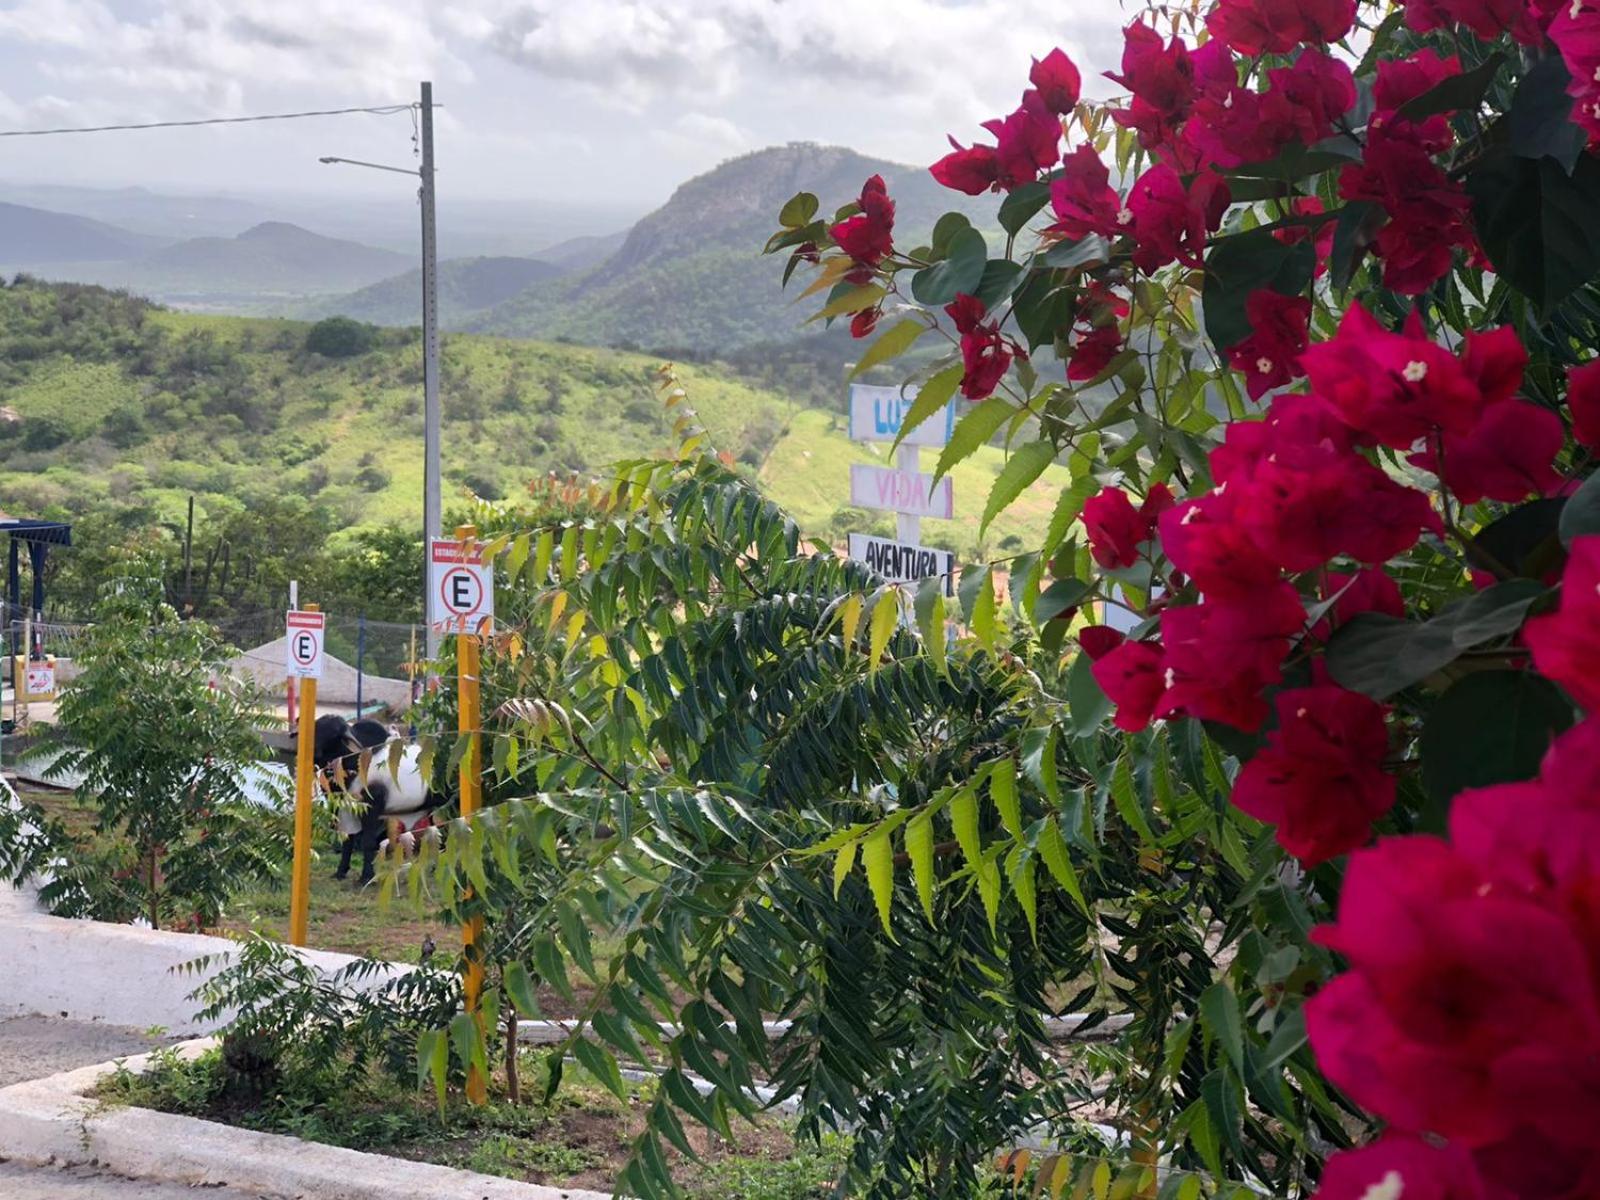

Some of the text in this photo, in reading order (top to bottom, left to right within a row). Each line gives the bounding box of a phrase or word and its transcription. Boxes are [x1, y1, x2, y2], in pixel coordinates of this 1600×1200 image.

[875, 468, 928, 512] VIDA
[865, 541, 938, 580] AVENTURA
[453, 576, 472, 608] E
[299, 636, 310, 659] E
